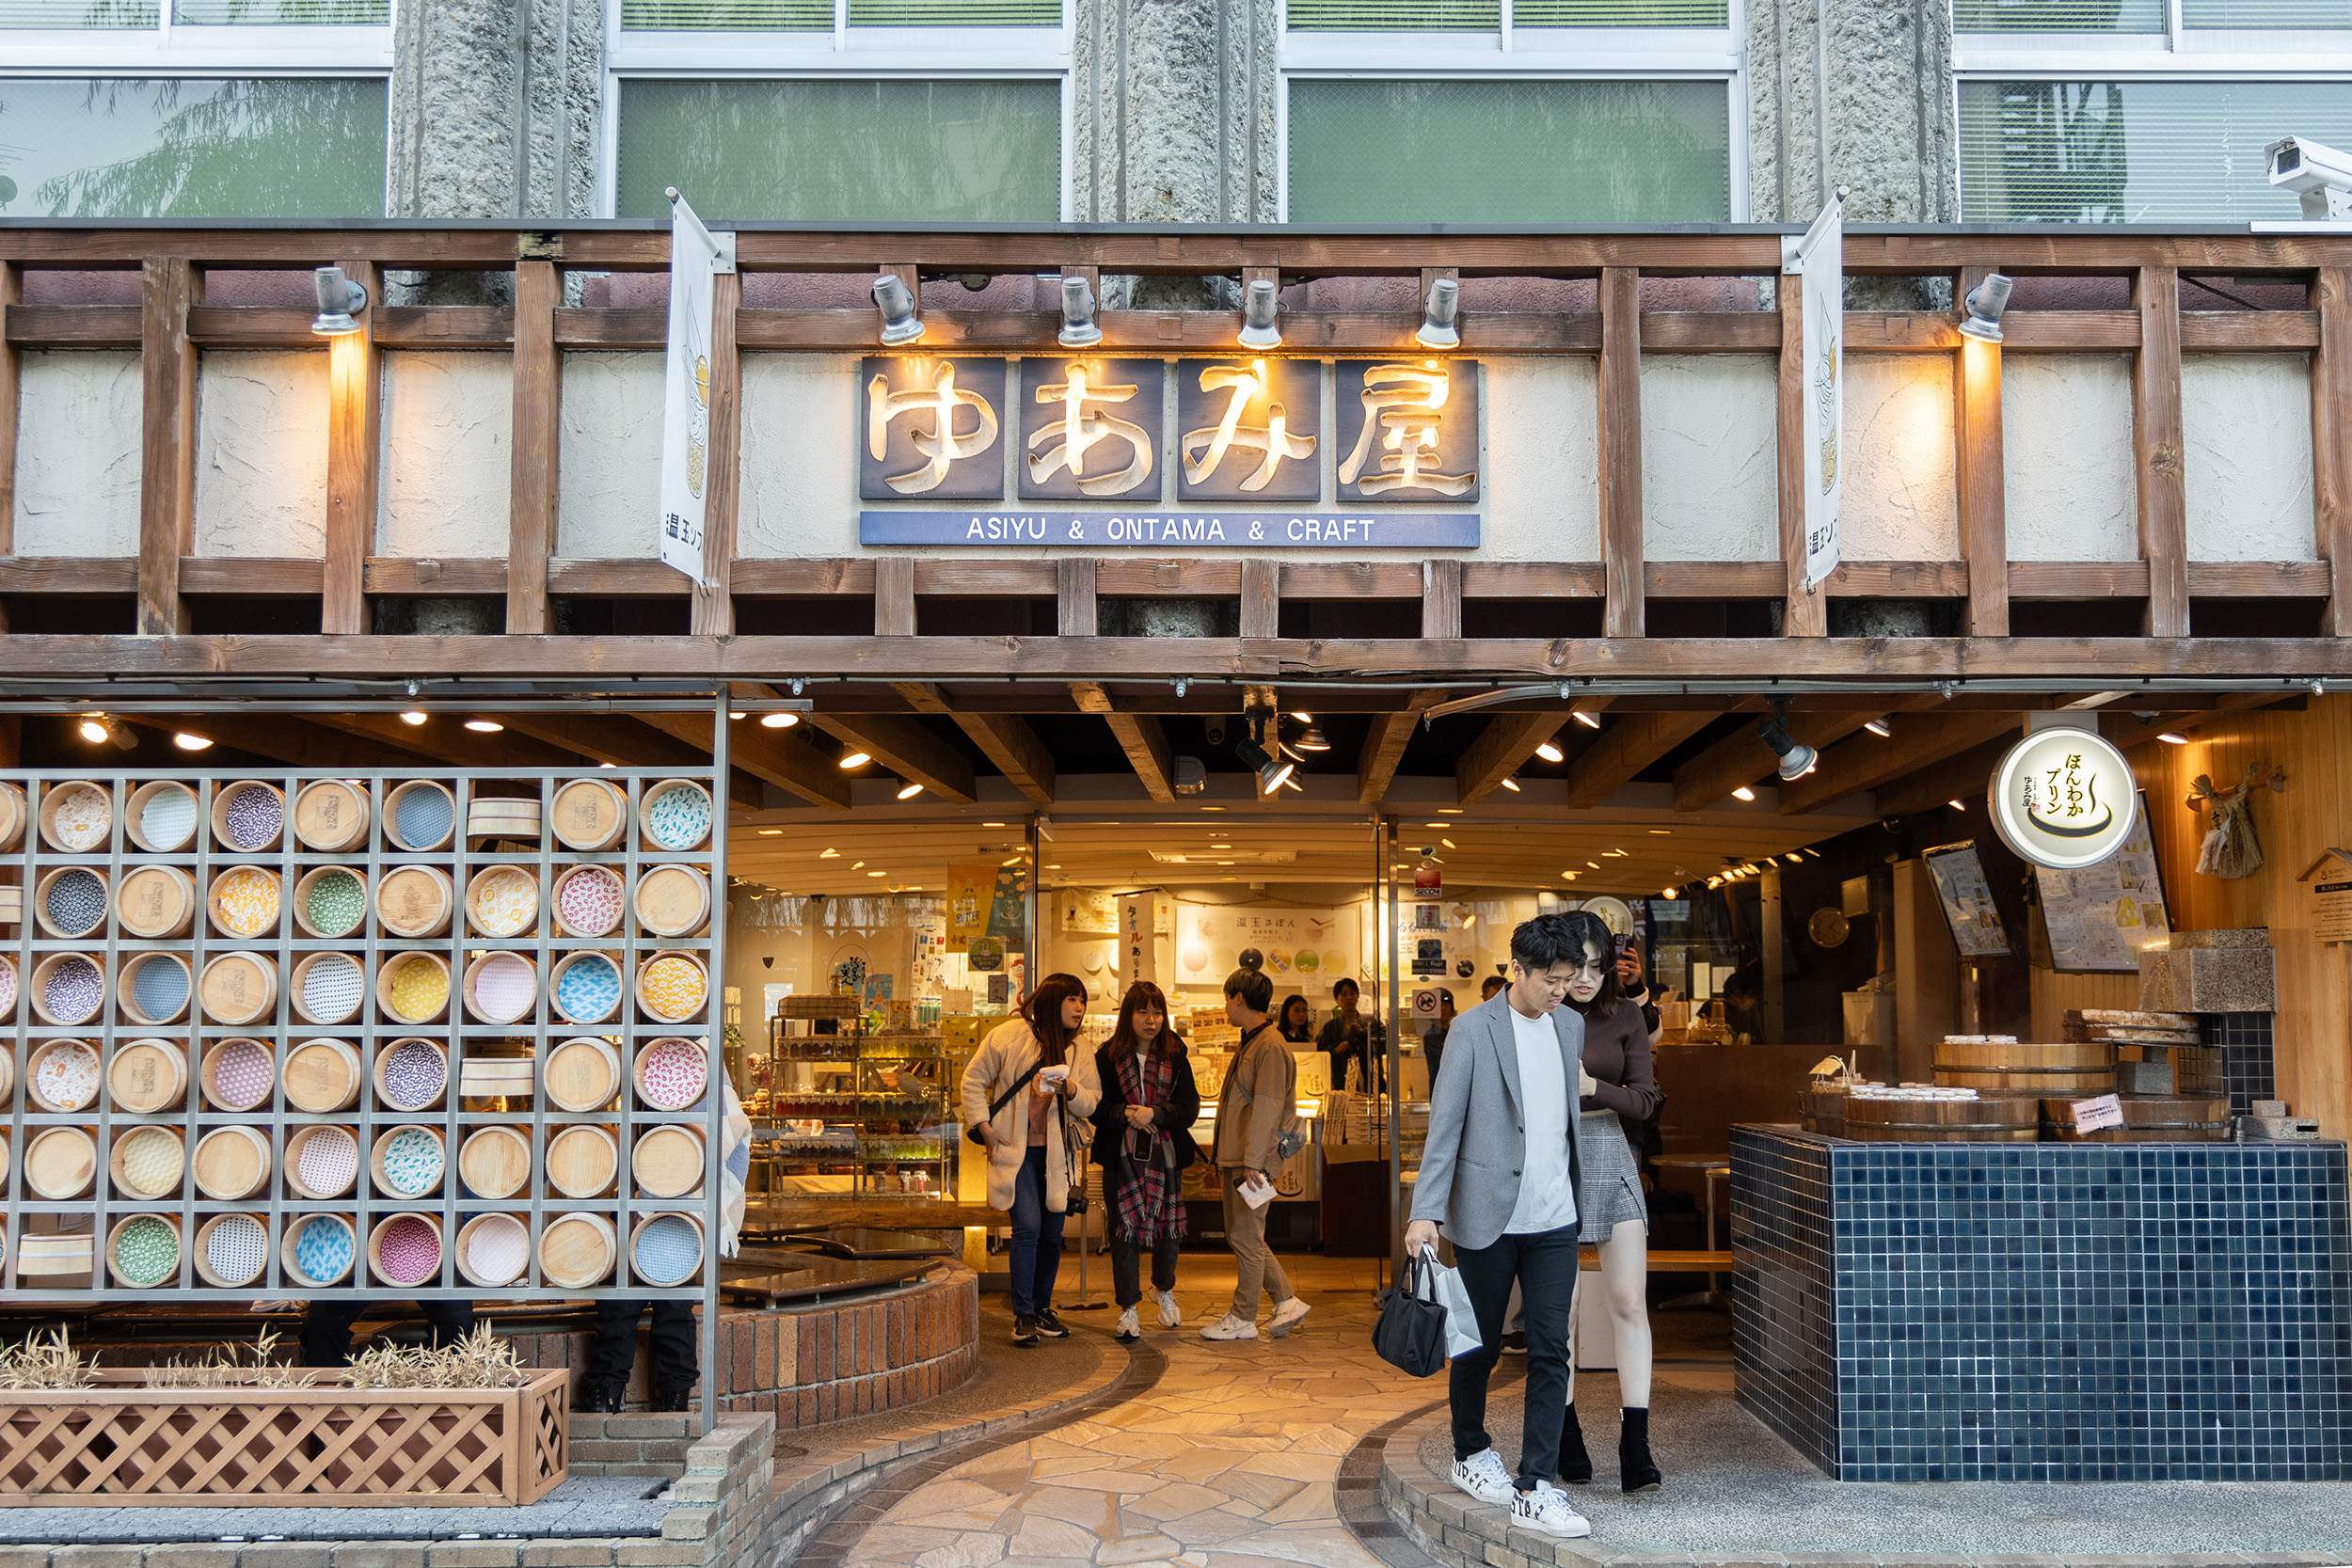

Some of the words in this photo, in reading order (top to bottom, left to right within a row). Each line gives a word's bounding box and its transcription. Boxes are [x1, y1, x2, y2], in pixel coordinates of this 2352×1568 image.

[868, 359, 1477, 496] ゆあみ屋
[965, 517, 1046, 540] ASIYU
[1068, 519, 1085, 540] &
[1106, 518, 1226, 541] ONTAMA
[1248, 520, 1264, 541] &
[1286, 518, 1375, 541] CRAFT
[2022, 776, 2033, 807] ゆあみ屋
[2046, 768, 2062, 815] プリン
[2065, 753, 2084, 817] ほんわか
